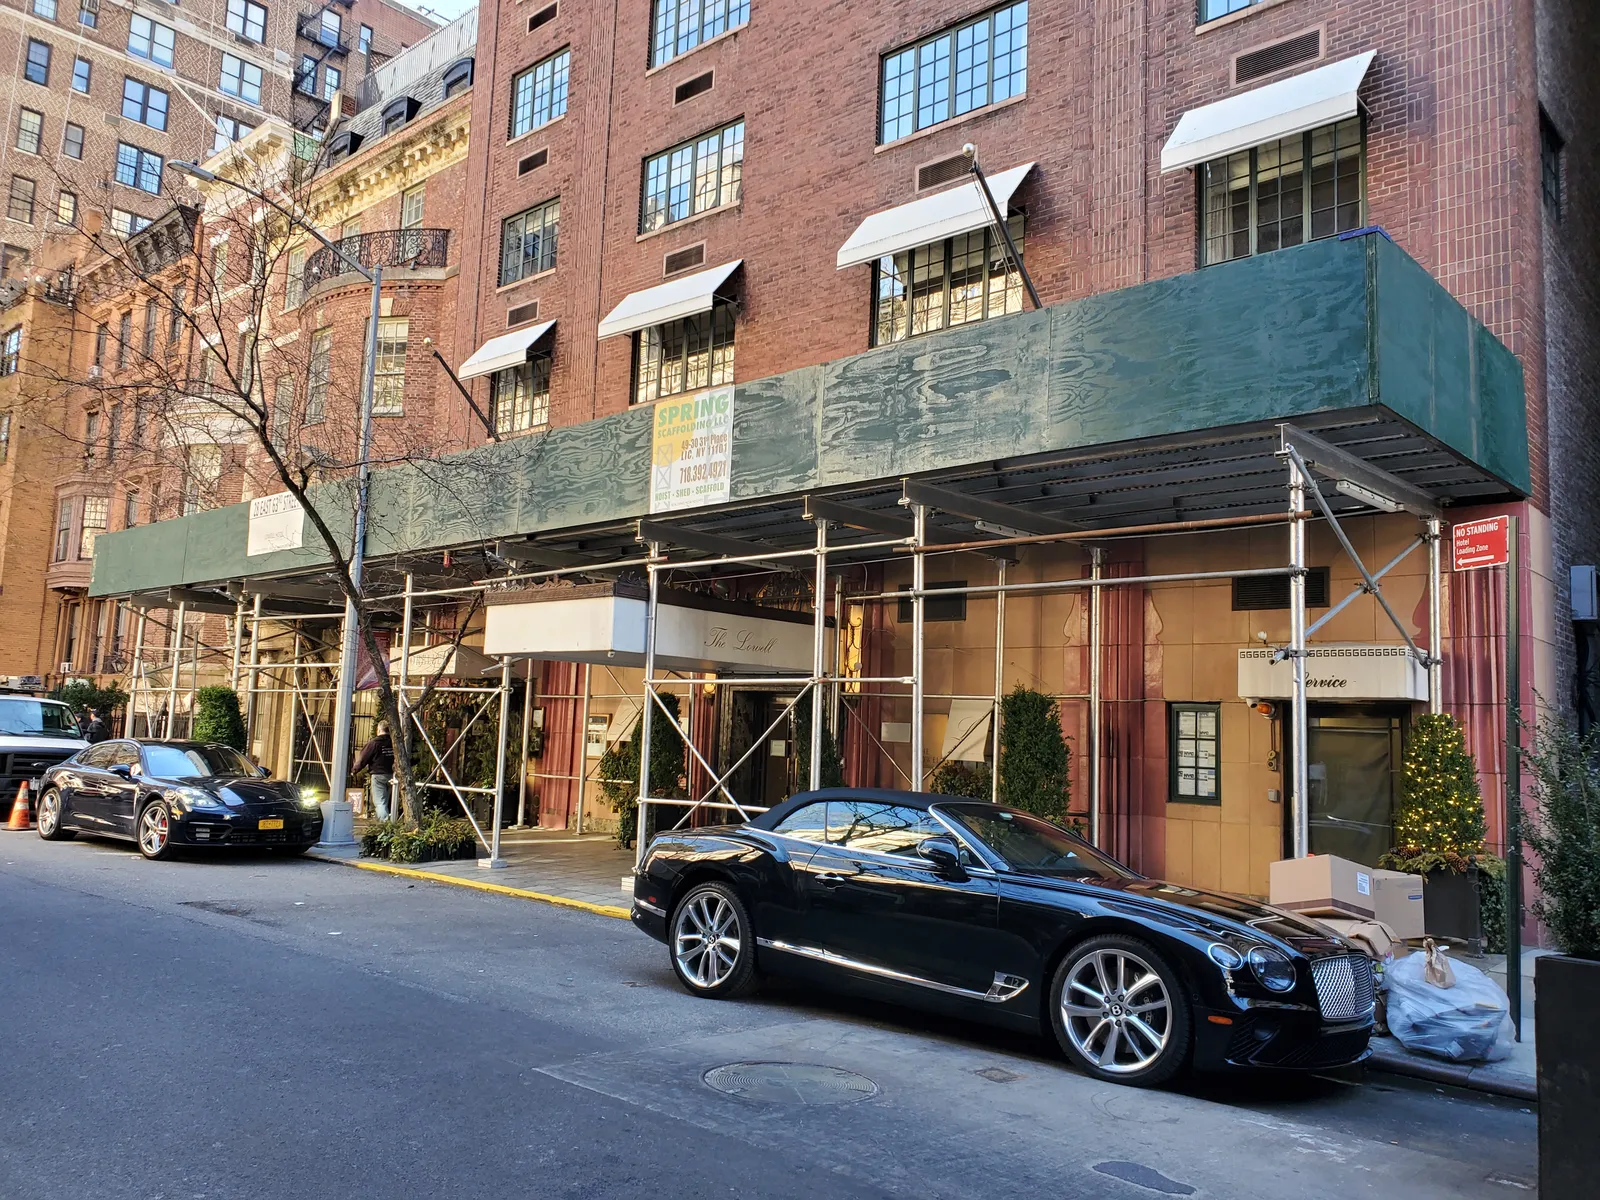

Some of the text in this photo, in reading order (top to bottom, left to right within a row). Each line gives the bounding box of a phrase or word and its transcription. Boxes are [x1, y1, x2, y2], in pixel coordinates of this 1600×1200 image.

[658, 394, 729, 427] SPRING
[658, 414, 729, 439] SCAFFOLDING LLC
[681, 437, 698, 450] 49-30
[710, 433, 728, 445] Place
[696, 447, 705, 458] NY
[708, 443, 727, 456] 11101
[655, 482, 725, 501] HOIST SHED SCAFFOLD
[1456, 521, 1499, 537] NO STANDING
[1456, 538, 1470, 547] Hotel
[1456, 544, 1489, 555] Loading Zone
[704, 626, 779, 654] The Lowell
